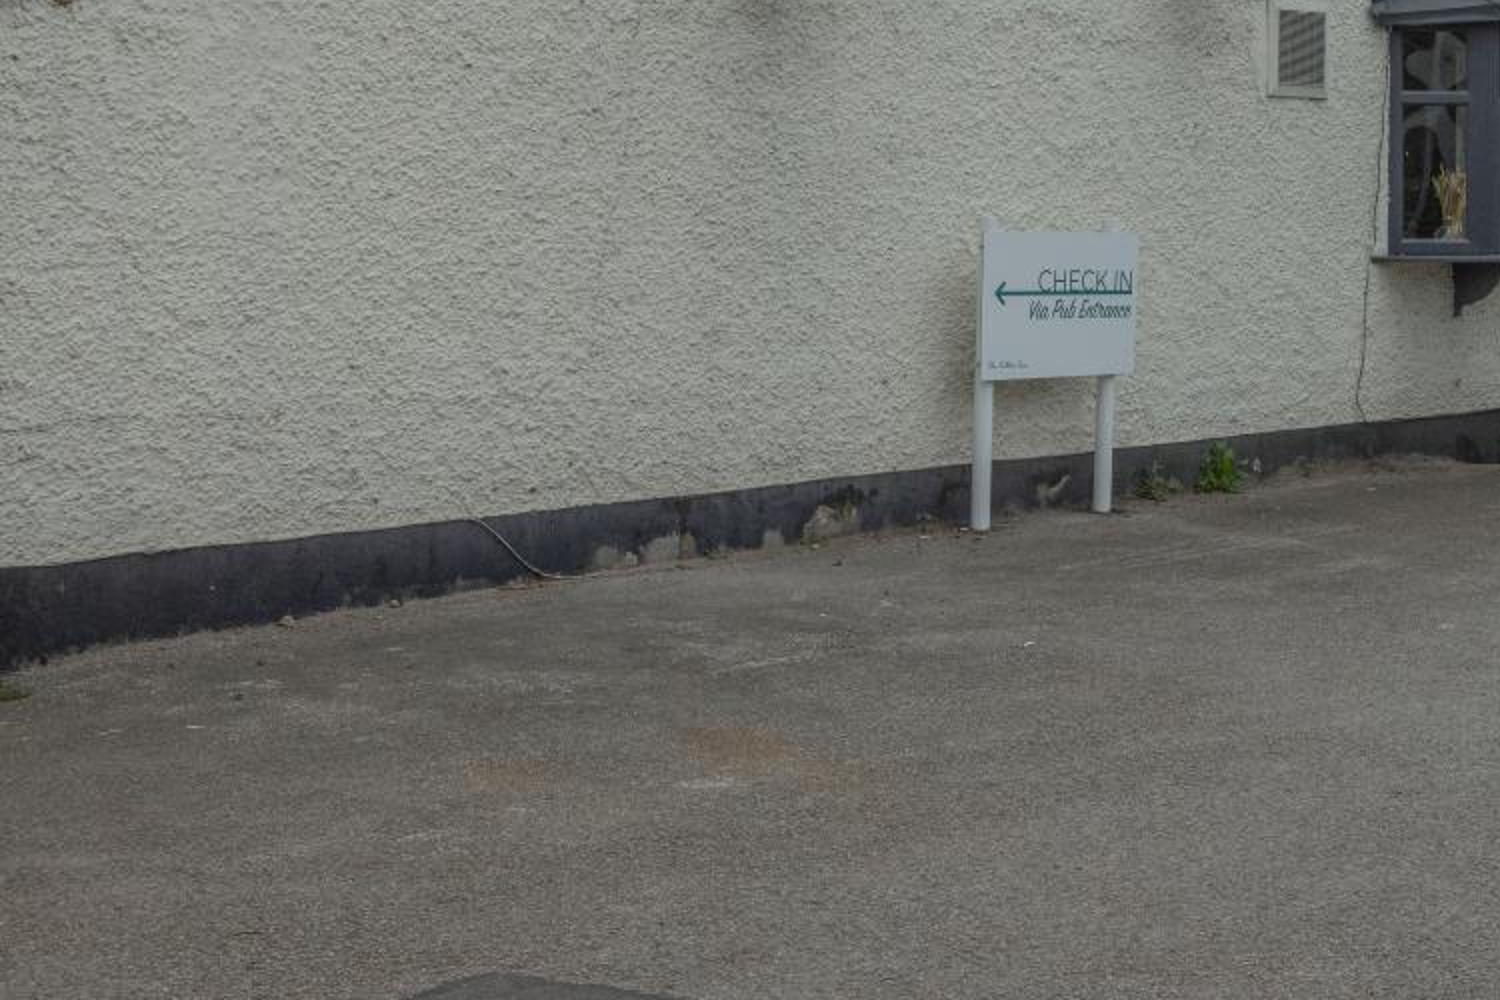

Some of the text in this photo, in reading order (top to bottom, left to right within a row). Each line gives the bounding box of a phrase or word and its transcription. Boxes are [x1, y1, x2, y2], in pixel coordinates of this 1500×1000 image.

[1038, 269, 1133, 294] CHECK IN
[1029, 299, 1132, 320] Via Pub Entrance
